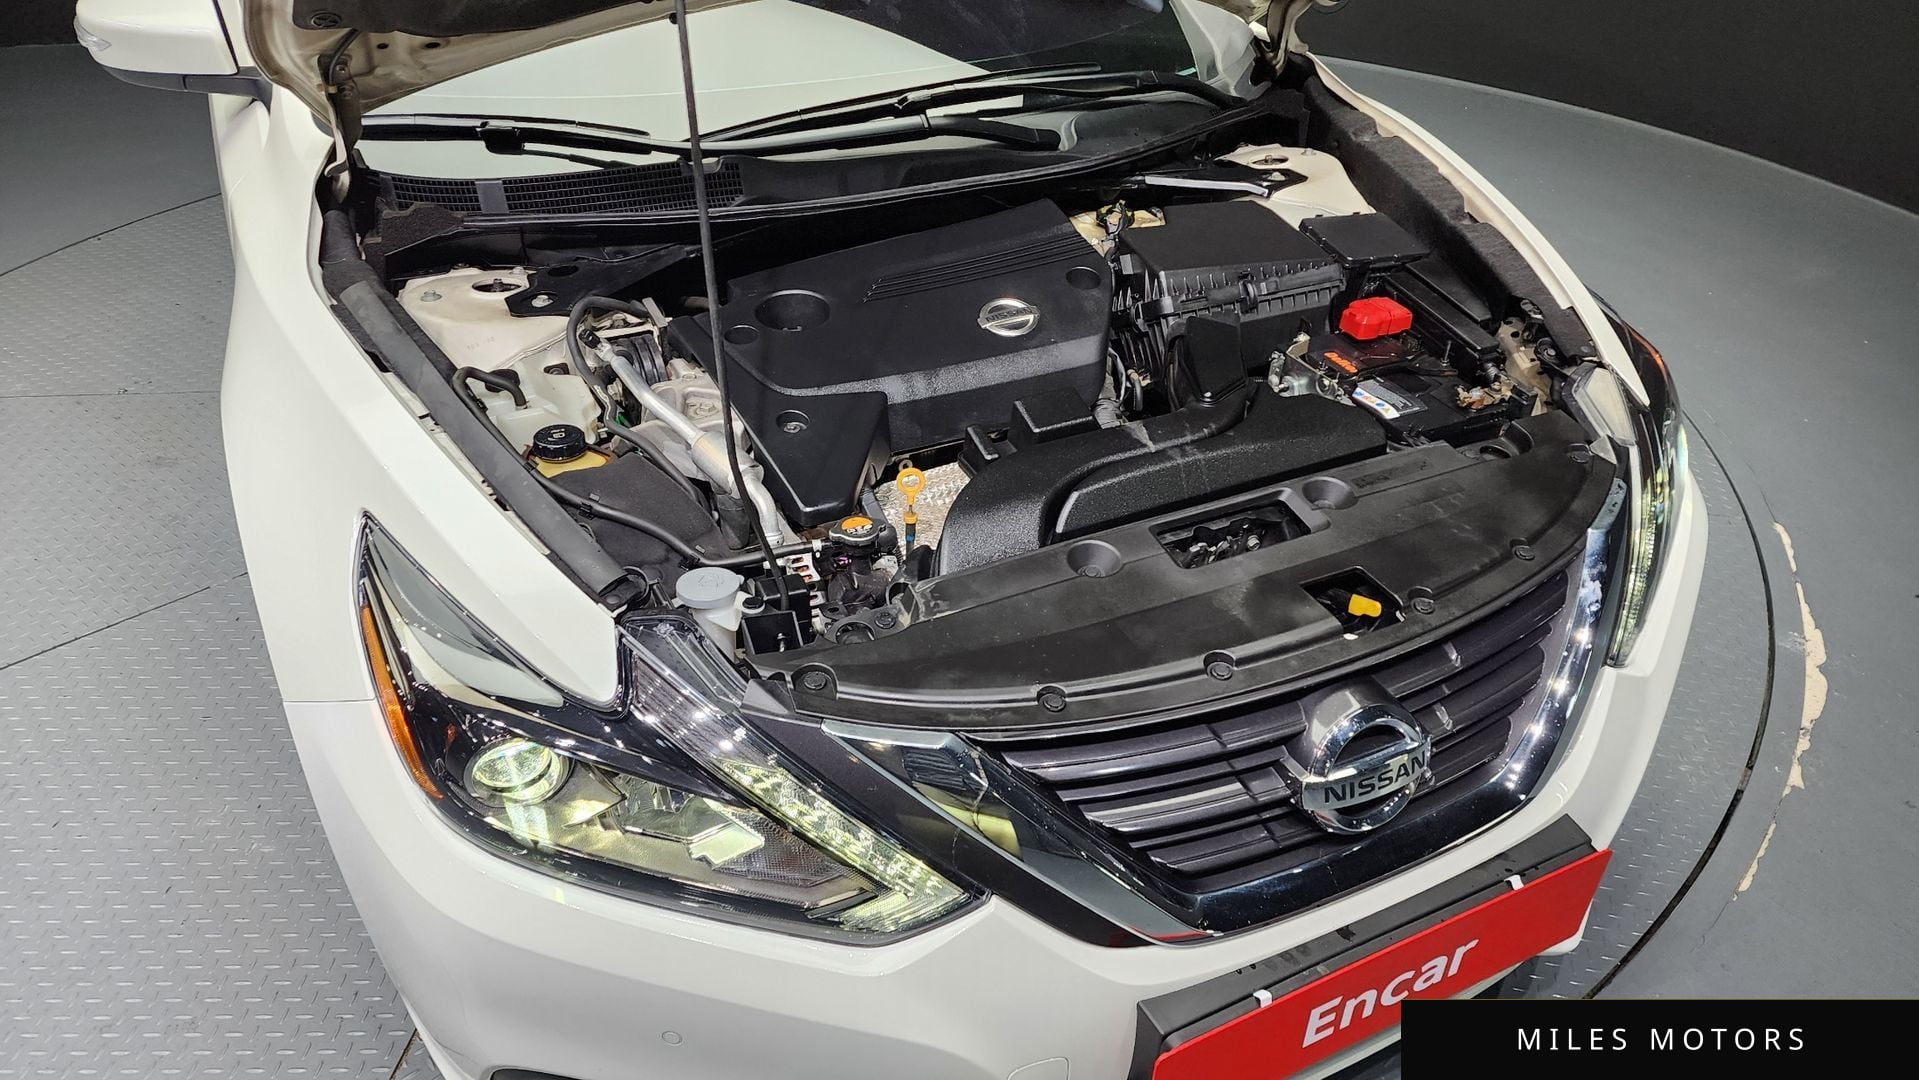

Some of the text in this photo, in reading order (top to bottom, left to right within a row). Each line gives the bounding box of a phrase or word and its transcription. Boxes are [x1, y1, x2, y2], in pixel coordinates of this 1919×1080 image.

[986, 308, 1033, 322] NISSAN
[1324, 752, 1426, 804] NISSAN
[1302, 938, 1479, 1049] Encar
